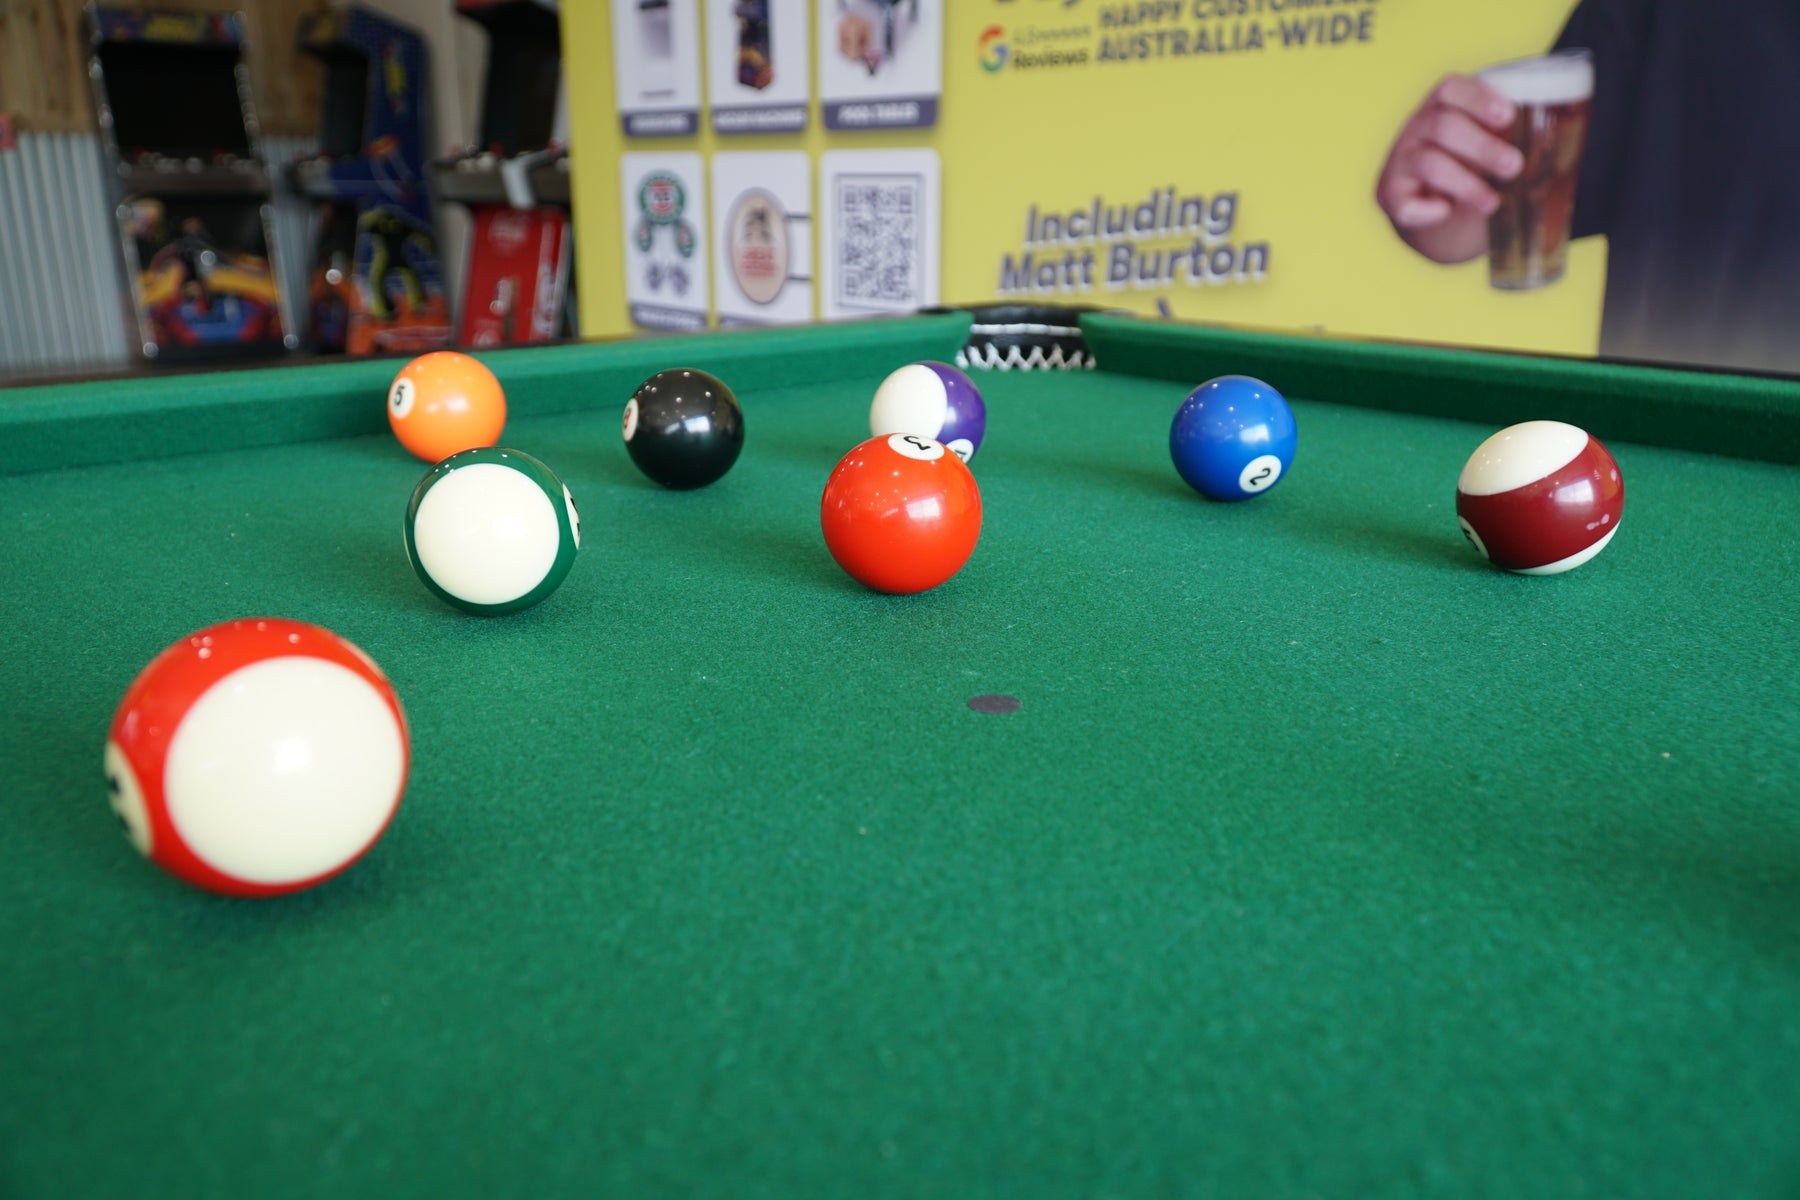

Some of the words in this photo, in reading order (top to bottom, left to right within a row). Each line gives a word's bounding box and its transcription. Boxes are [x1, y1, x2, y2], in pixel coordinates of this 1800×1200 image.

[1098, 1, 1184, 27] HAPPY
[1193, 0, 1380, 18] CUSTO
[1097, 10, 1376, 61] AUSTRALIA-WIDE
[1024, 186, 1240, 242] Including
[999, 251, 1095, 292] Matt
[1106, 240, 1271, 285] Burton
[394, 384, 405, 406] 5
[1249, 467, 1271, 486] 2
